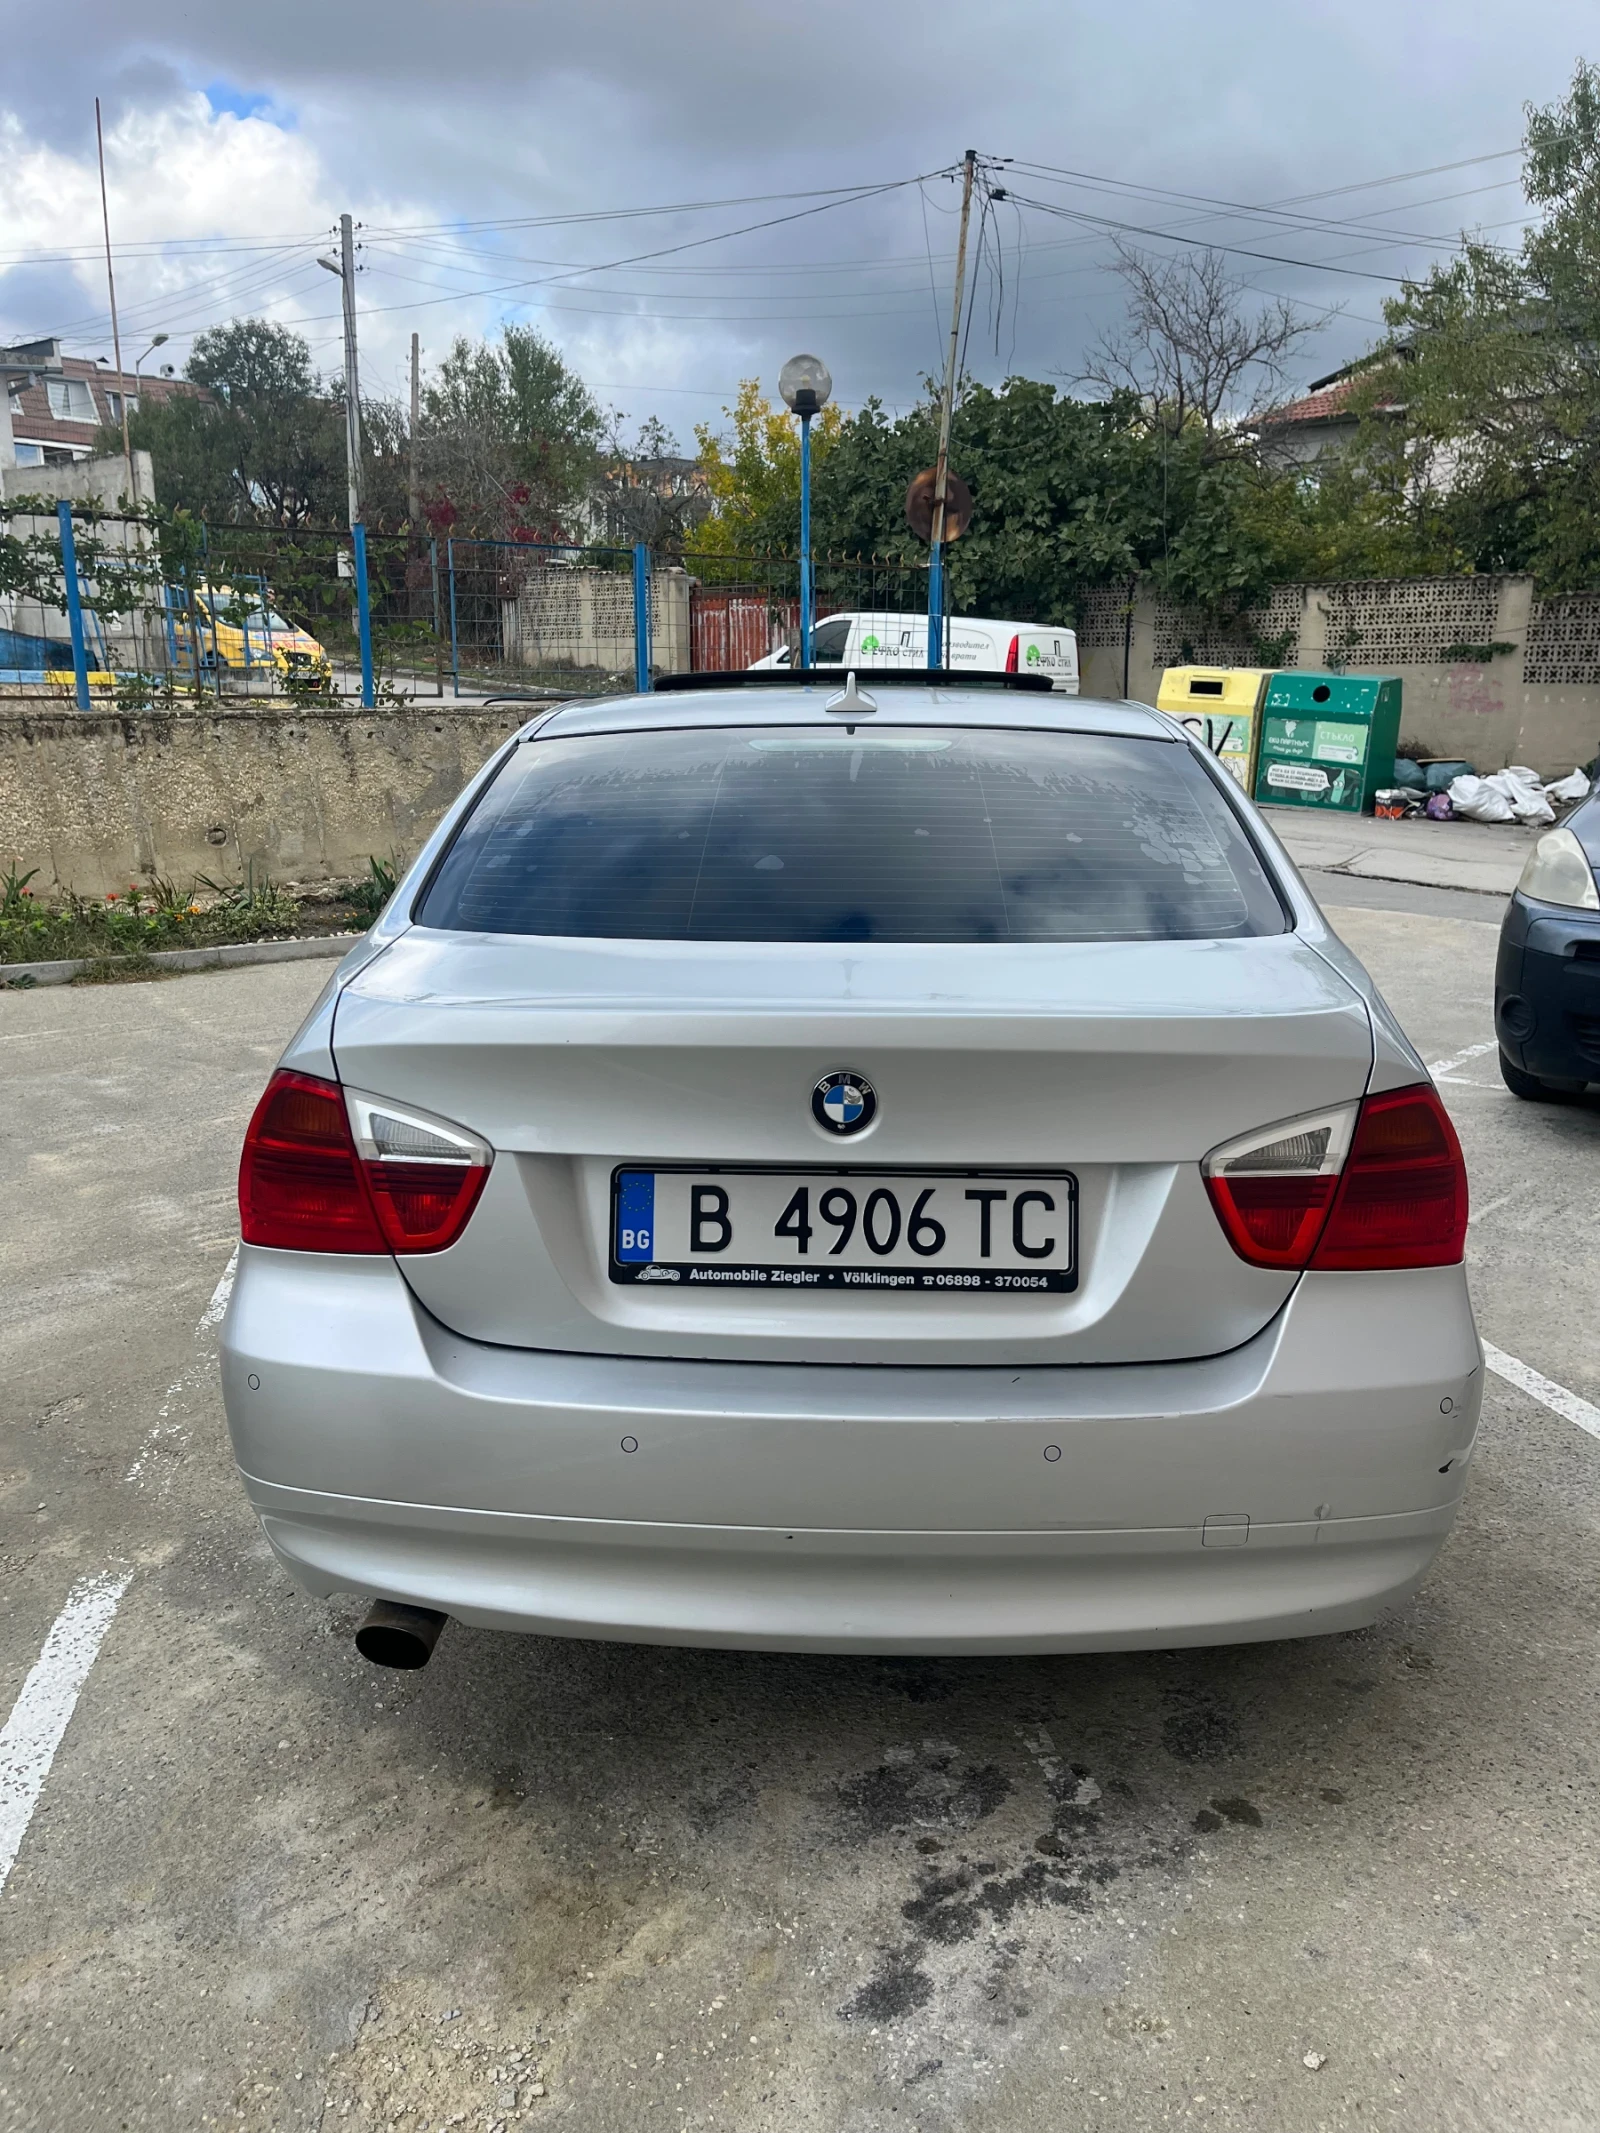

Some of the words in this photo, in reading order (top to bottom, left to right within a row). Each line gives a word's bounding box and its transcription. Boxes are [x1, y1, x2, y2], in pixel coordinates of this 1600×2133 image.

[1320, 731, 1354, 743] СТЪКЛО
[818, 1074, 872, 1094] BMW
[690, 1185, 732, 1252] B
[774, 1186, 946, 1256] 4906
[965, 1189, 1055, 1259] TC
[622, 1229, 650, 1249] BG
[689, 1268, 767, 1281] Automobile
[771, 1270, 820, 1284] Ziegler
[843, 1271, 915, 1286] Völklingen
[936, 1274, 981, 1286] 06898
[994, 1276, 1048, 1287] 370054
